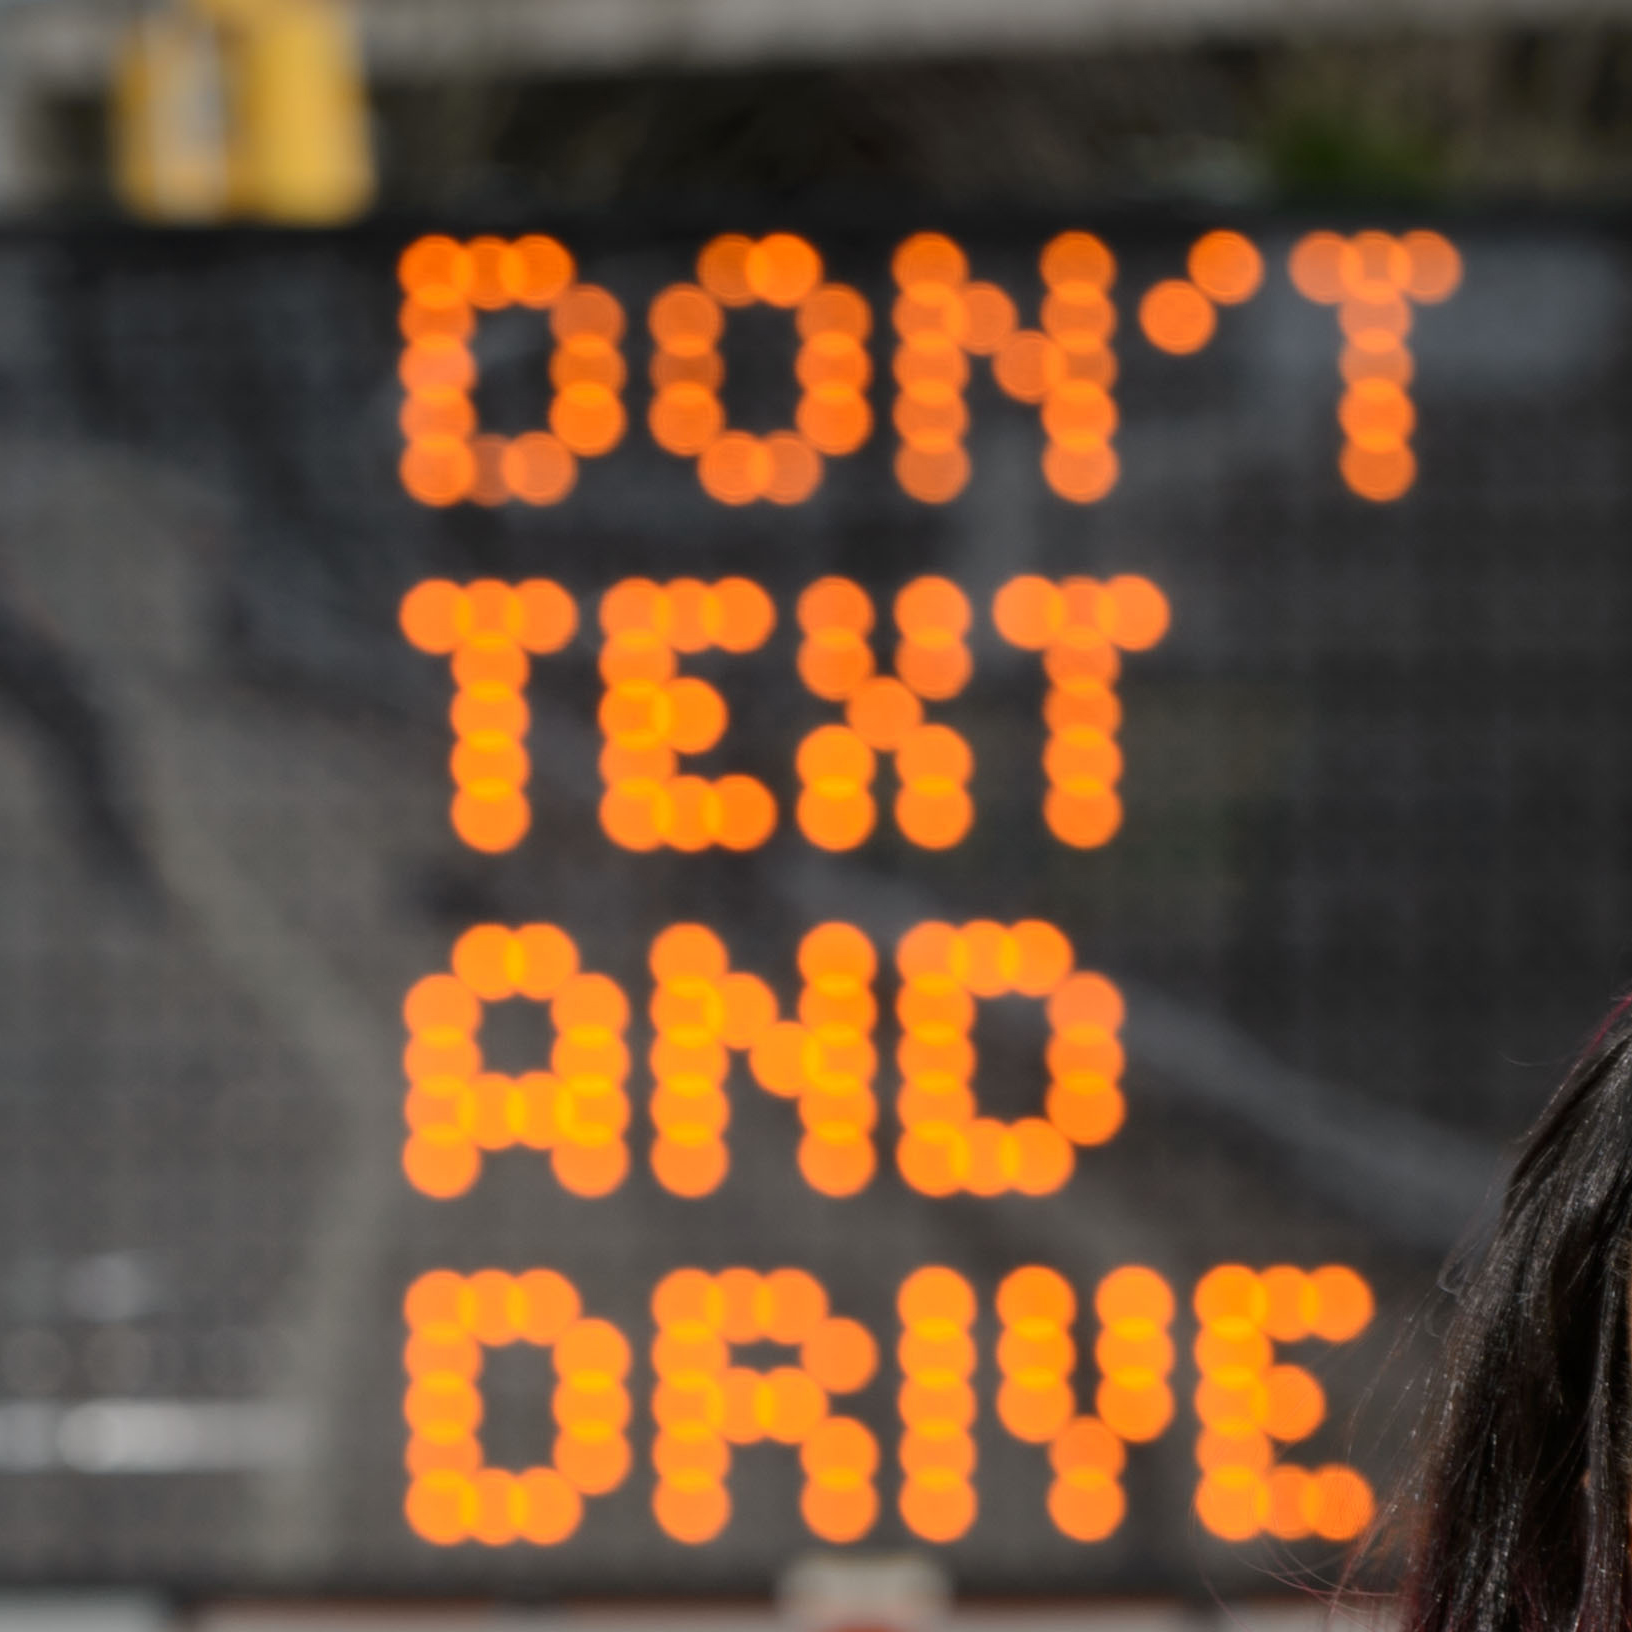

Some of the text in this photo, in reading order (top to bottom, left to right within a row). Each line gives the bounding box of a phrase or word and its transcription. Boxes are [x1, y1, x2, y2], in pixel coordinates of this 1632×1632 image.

[398, 230, 1462, 507] DON'T
[398, 574, 1171, 853] TEXT
[401, 919, 1127, 1198] AND
[402, 1263, 1376, 1546] DRIVE
